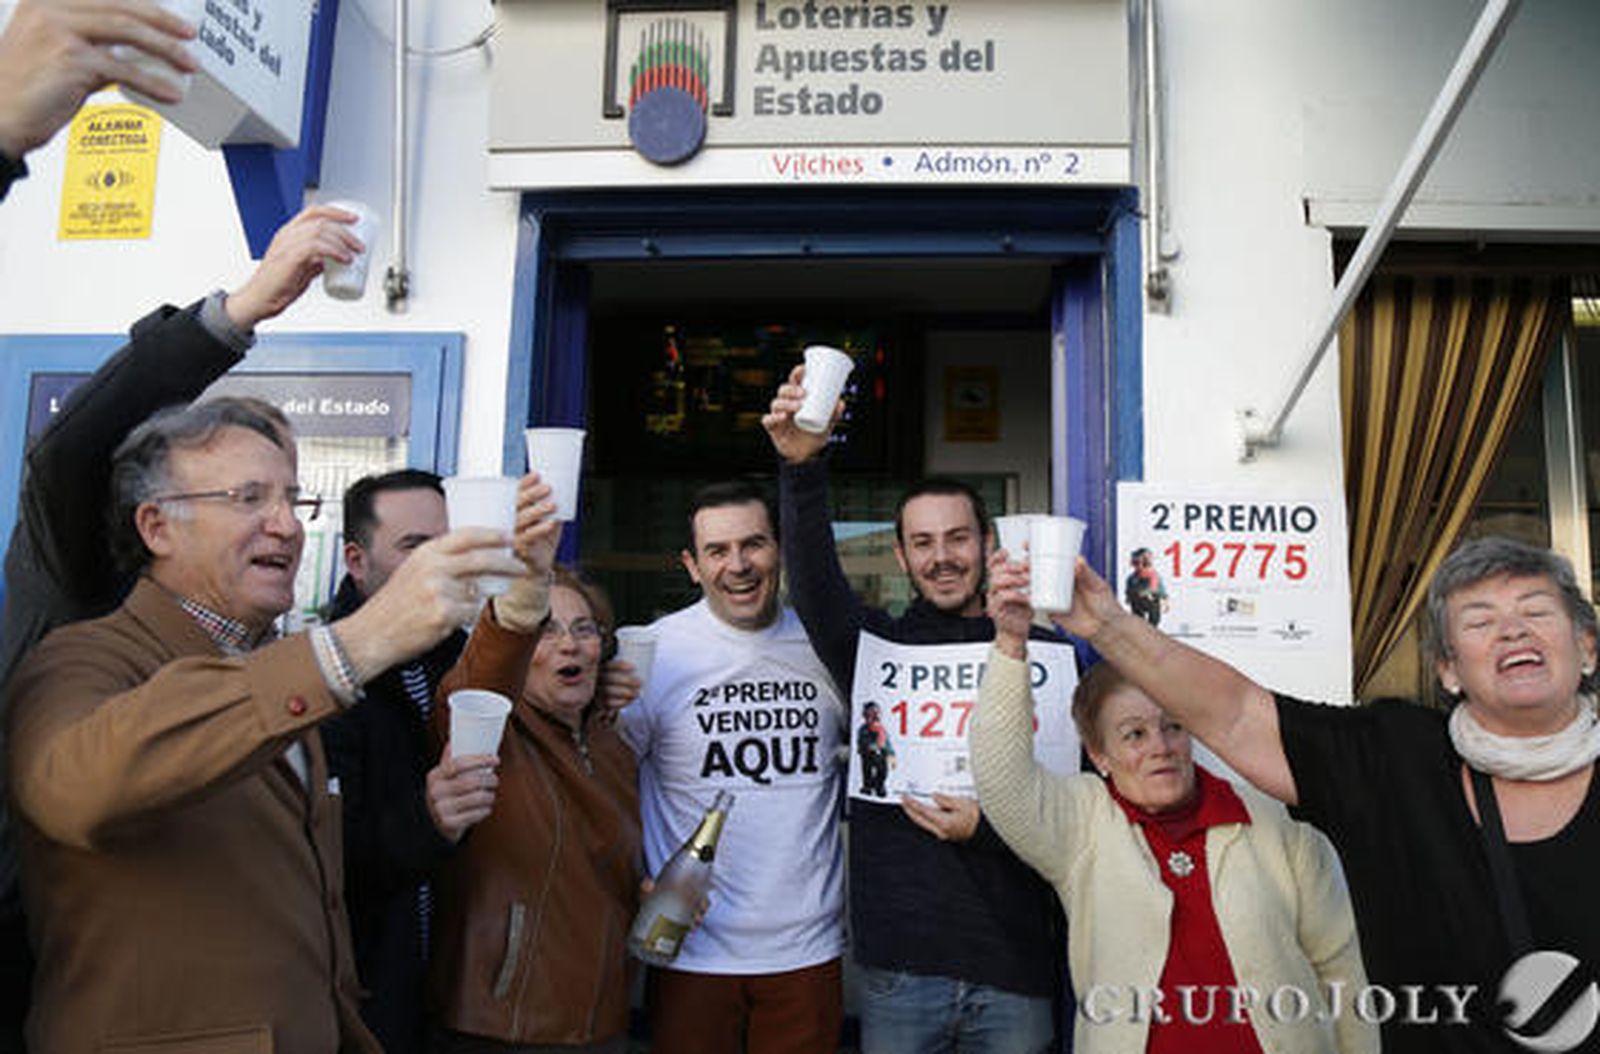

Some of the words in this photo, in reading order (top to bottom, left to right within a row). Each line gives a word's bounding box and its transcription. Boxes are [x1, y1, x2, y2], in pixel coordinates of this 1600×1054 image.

[926, 4, 949, 37] y
[754, 43, 927, 81] Apuestas
[939, 40, 995, 72] del
[753, 84, 883, 115] Estado
[772, 153, 864, 177] Vilches
[1063, 152, 1080, 175] 2
[319, 397, 391, 416] Estado
[1184, 503, 1318, 533] PREMIO
[1164, 541, 1309, 580] 12775
[910, 661, 1049, 692] PREO
[724, 681, 818, 704] PREMIO
[696, 707, 819, 734] VENDIDO
